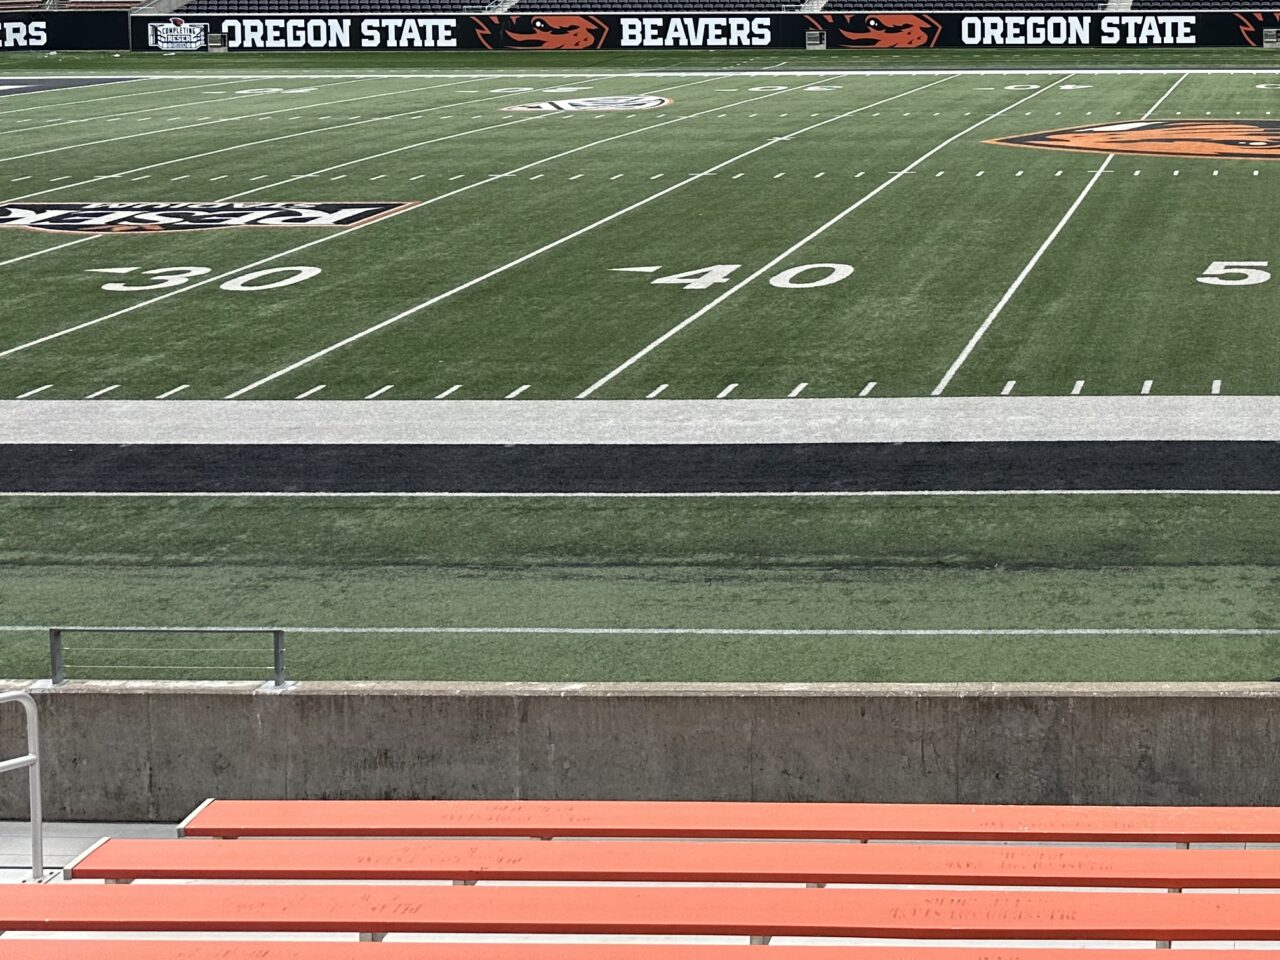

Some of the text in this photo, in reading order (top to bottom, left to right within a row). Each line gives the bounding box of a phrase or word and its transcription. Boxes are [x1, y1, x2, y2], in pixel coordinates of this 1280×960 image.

[0, 21, 47, 47] RS
[222, 19, 456, 47] OREGON STATE
[621, 18, 771, 46] BEAVERS
[962, 16, 1195, 44] OREGON STATE
